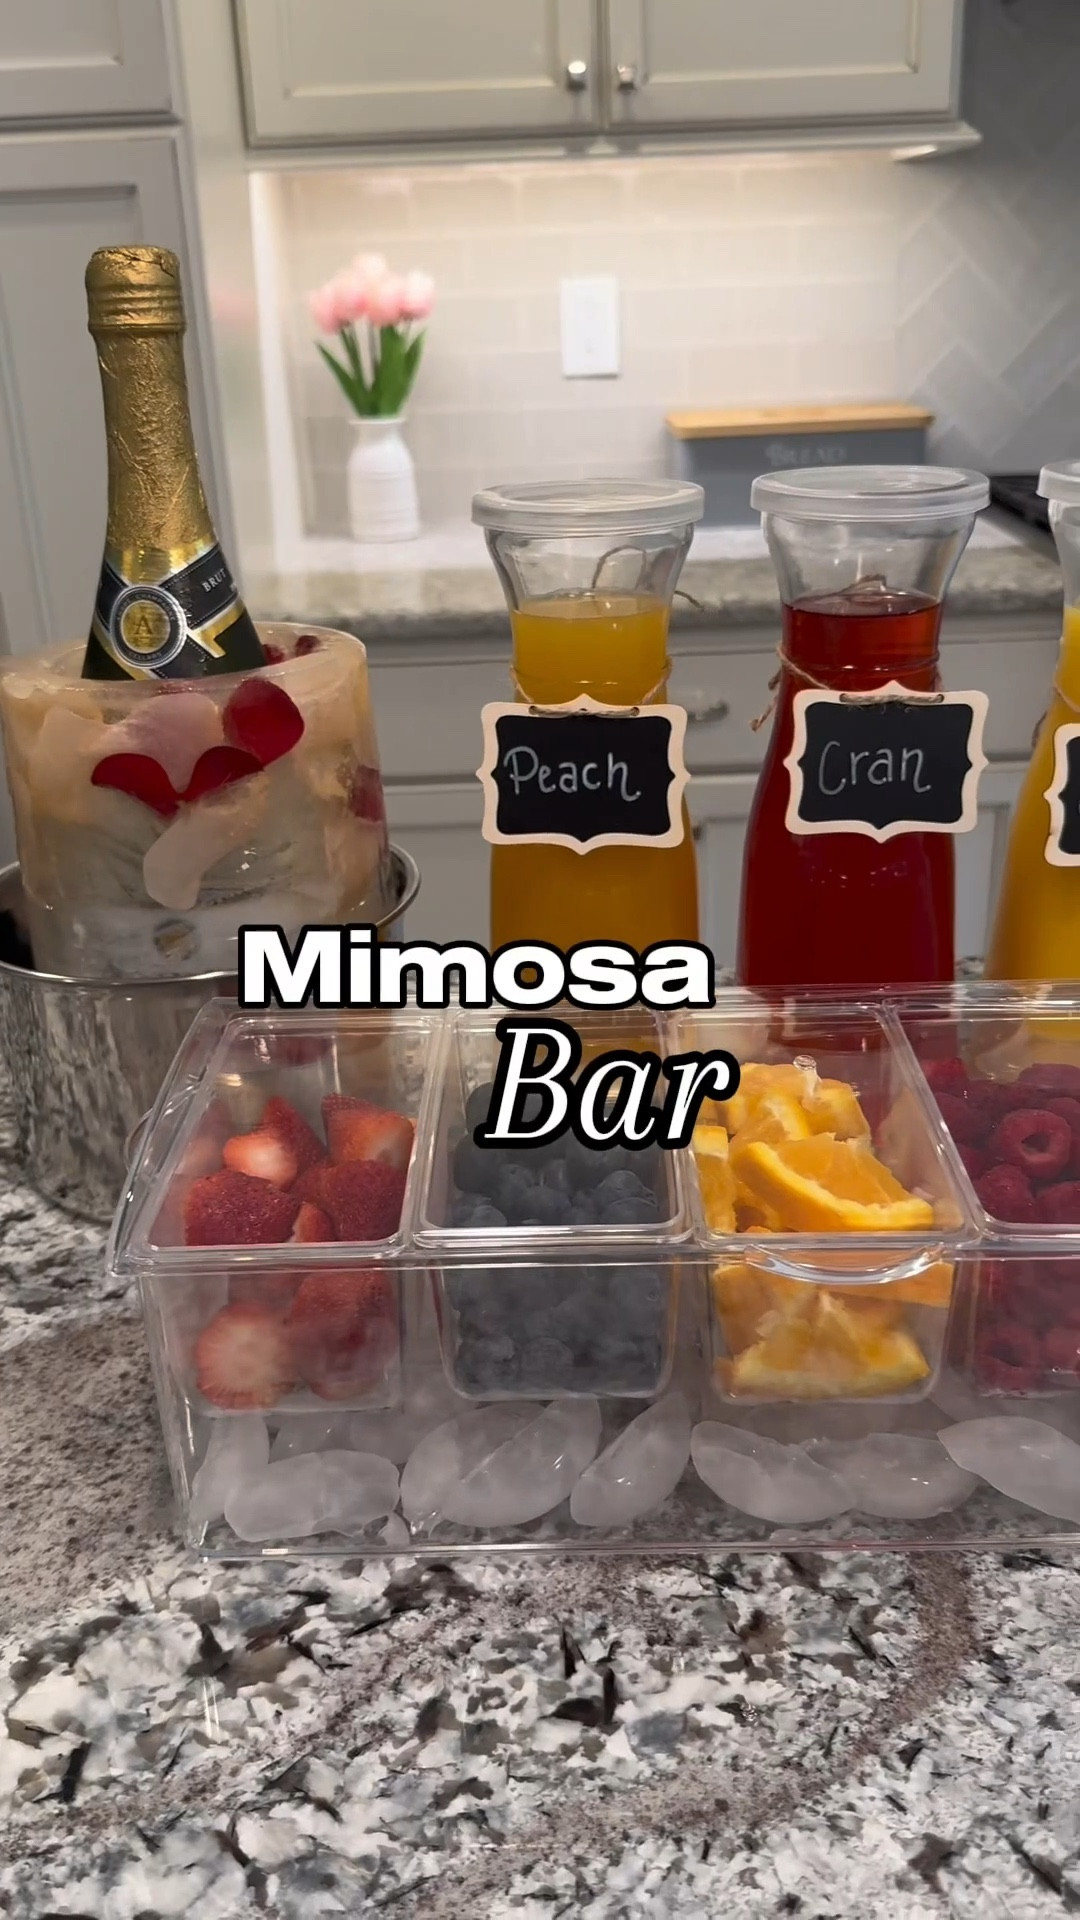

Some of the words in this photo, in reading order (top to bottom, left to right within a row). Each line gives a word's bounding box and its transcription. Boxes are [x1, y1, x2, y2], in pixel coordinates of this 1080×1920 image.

[202, 568, 226, 592] BRUT
[136, 614, 153, 635] A
[503, 746, 641, 802] Peach
[818, 741, 932, 795] Cran
